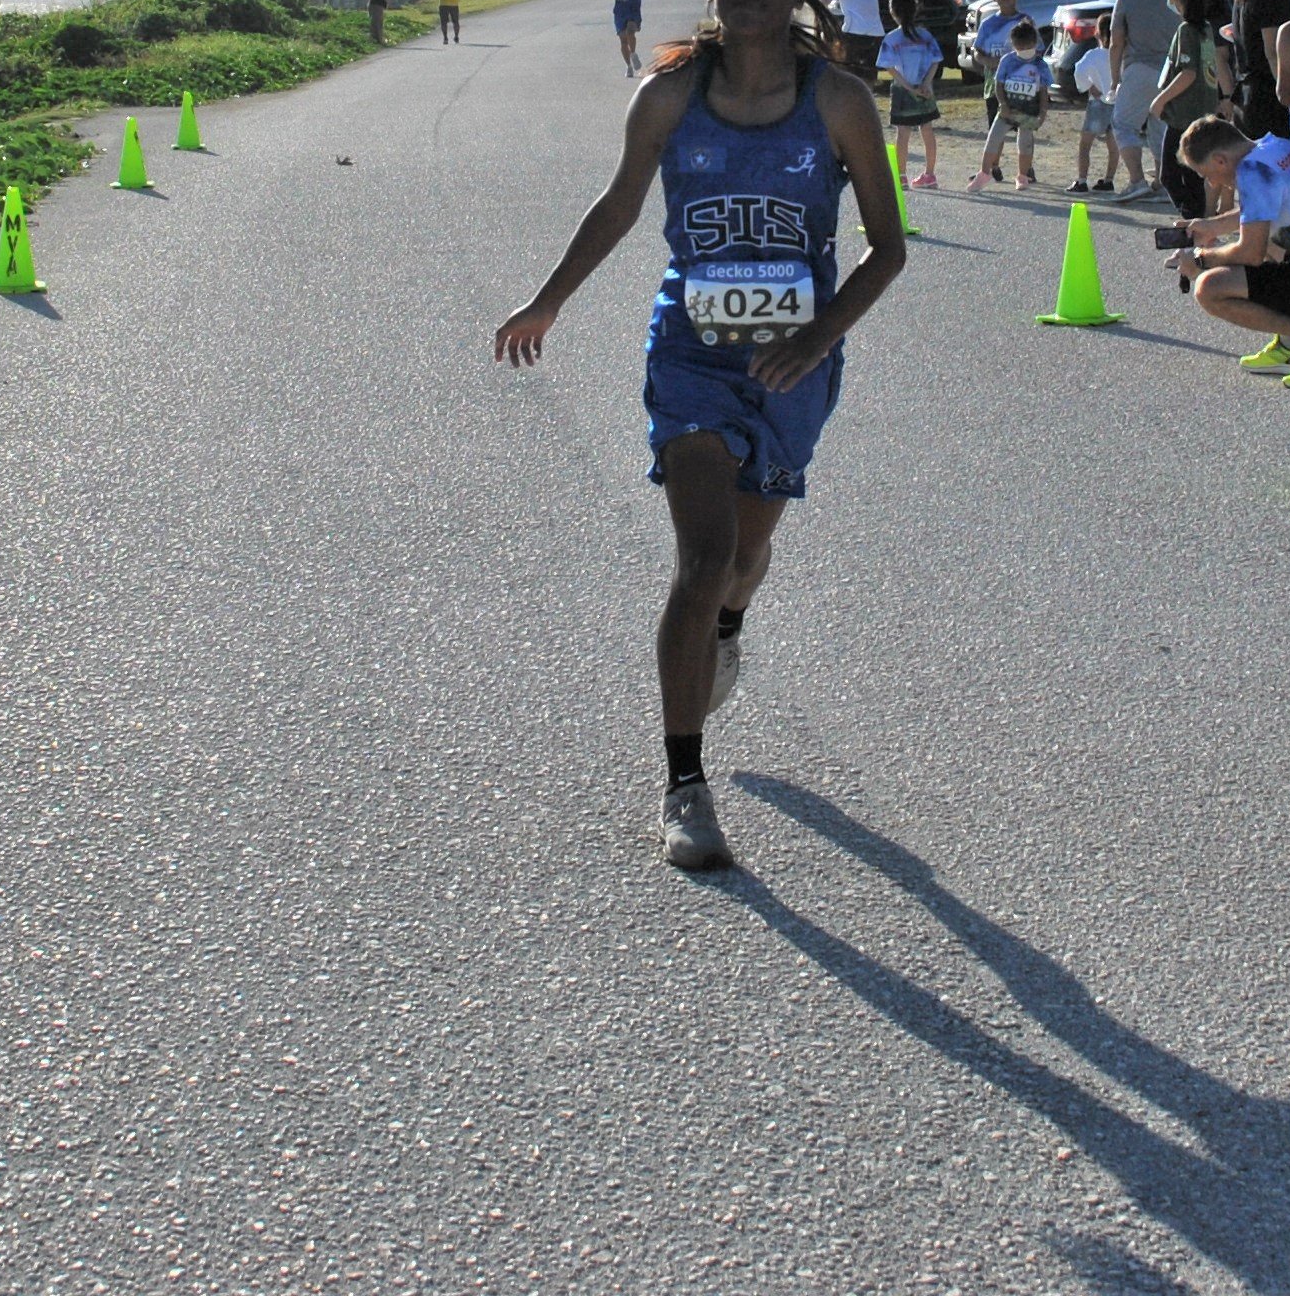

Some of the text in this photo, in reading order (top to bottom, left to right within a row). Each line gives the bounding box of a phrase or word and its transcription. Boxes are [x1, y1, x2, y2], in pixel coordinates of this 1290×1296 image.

[683, 194, 809, 256] SIS
[705, 263, 795, 278] Gecko 5000
[723, 287, 801, 318] 024
